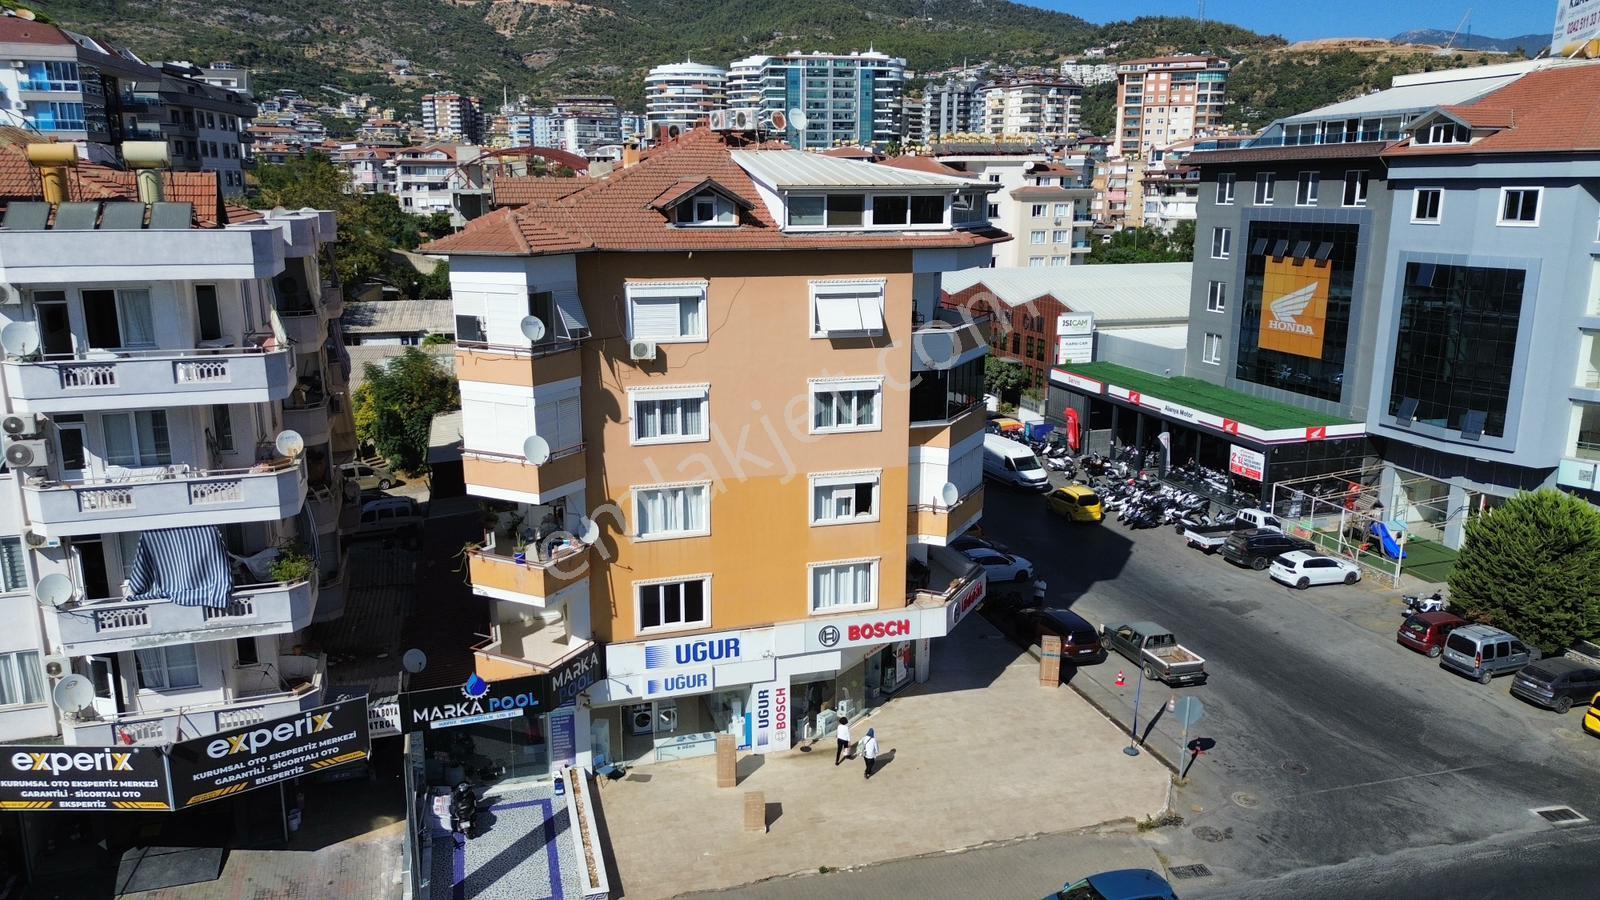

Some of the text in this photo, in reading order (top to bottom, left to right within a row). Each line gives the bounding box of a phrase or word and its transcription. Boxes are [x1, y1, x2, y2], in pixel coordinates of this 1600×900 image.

[1268, 319, 1315, 336] HONDA
[1164, 404, 1194, 418] Alanya Motor
[848, 619, 910, 641] BOSCH
[675, 637, 740, 665] UĞUR
[552, 651, 598, 691] MARKA
[664, 673, 708, 692] UĞUR
[559, 671, 594, 699] POOL
[381, 706, 398, 718] BOYA
[413, 691, 539, 723] MARKA POOL
[775, 687, 786, 730] BOSCH
[206, 712, 333, 758] experix
[11, 748, 134, 776] experix
[193, 762, 246, 781] KURUMSAL
[248, 756, 268, 767] OTO
[269, 742, 317, 761] EKSPERTİZ
[319, 730, 357, 748] MERKEZİ
[214, 766, 265, 785] GARANTİLİ
[272, 752, 319, 770] SİGORTALI
[320, 747, 340, 758] OTO
[0, 779, 159, 788] KURUMSAL OTO EKSPERTİZ MERKEZİ
[255, 766, 304, 785] EKSPERTİZ
[21, 789, 68, 798] GARANTİLİ
[75, 789, 121, 798] SİGORTALI
[59, 799, 107, 808] EKSPERTİZ
